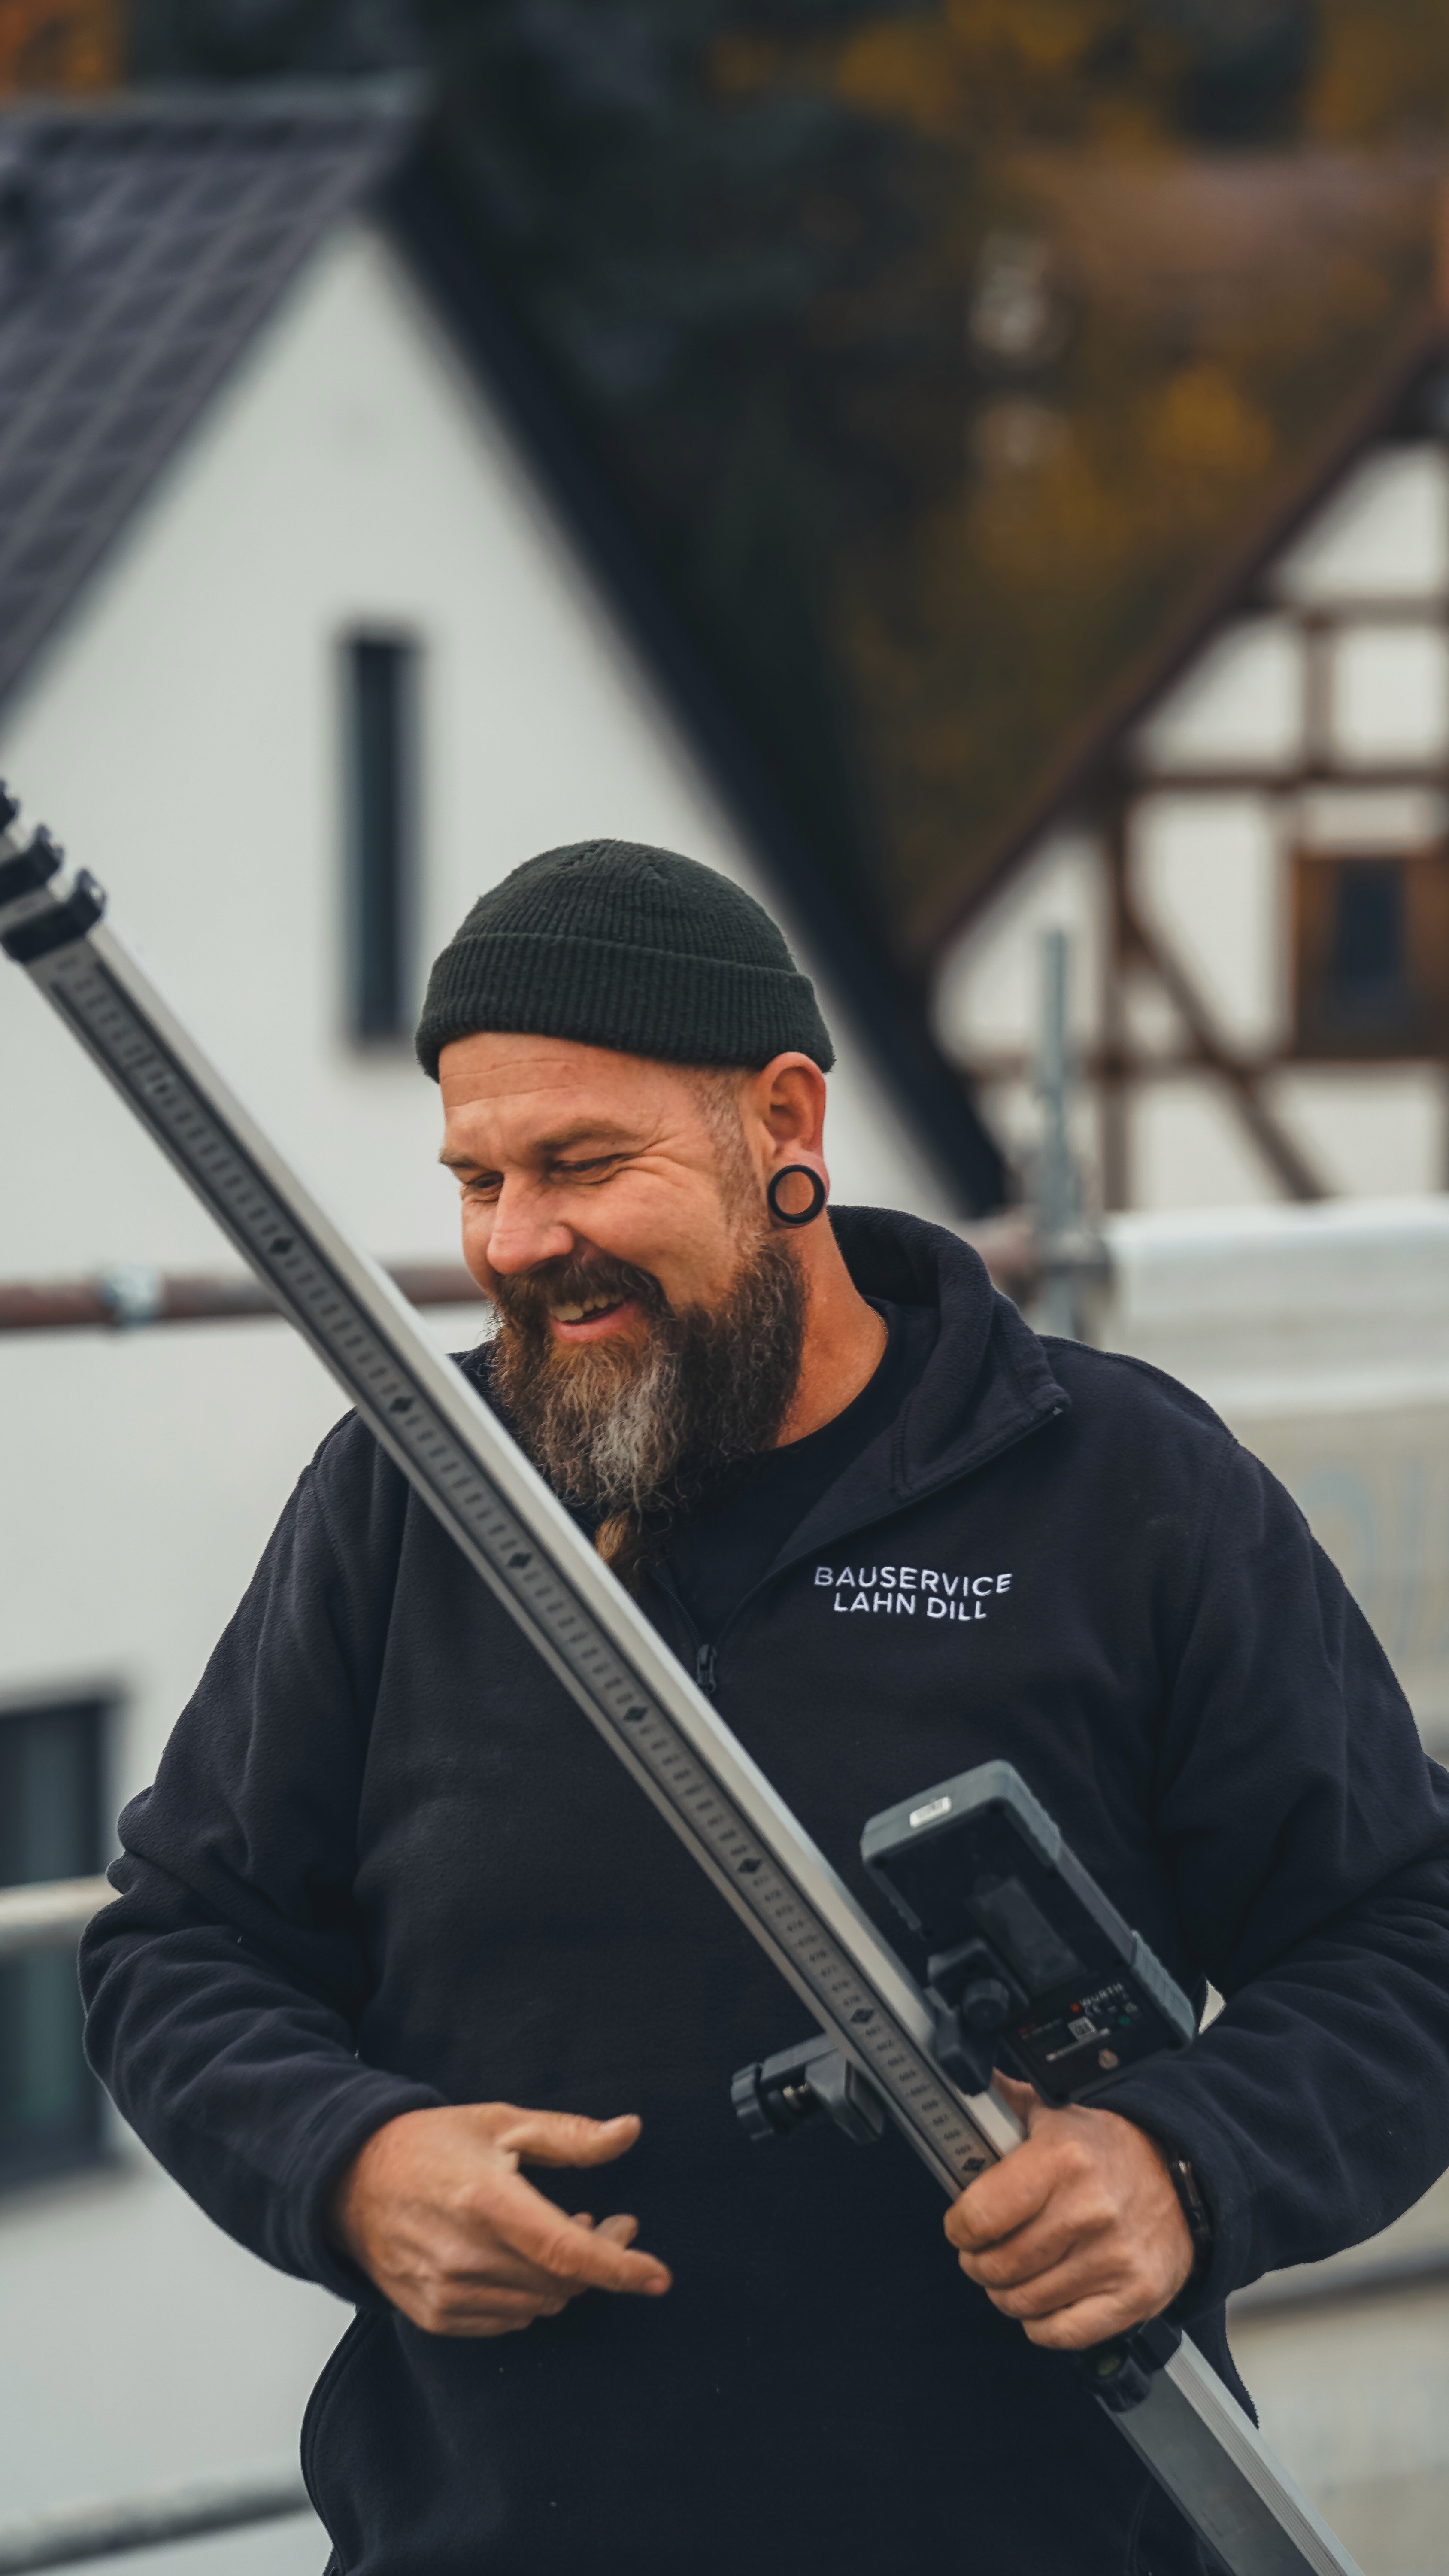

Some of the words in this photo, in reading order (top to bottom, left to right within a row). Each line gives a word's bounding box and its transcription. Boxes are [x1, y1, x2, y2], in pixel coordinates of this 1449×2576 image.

[814, 1566, 1012, 1596] BAUSERVICE
[834, 1591, 916, 1615] LAHN
[927, 1596, 987, 1621] DILL
